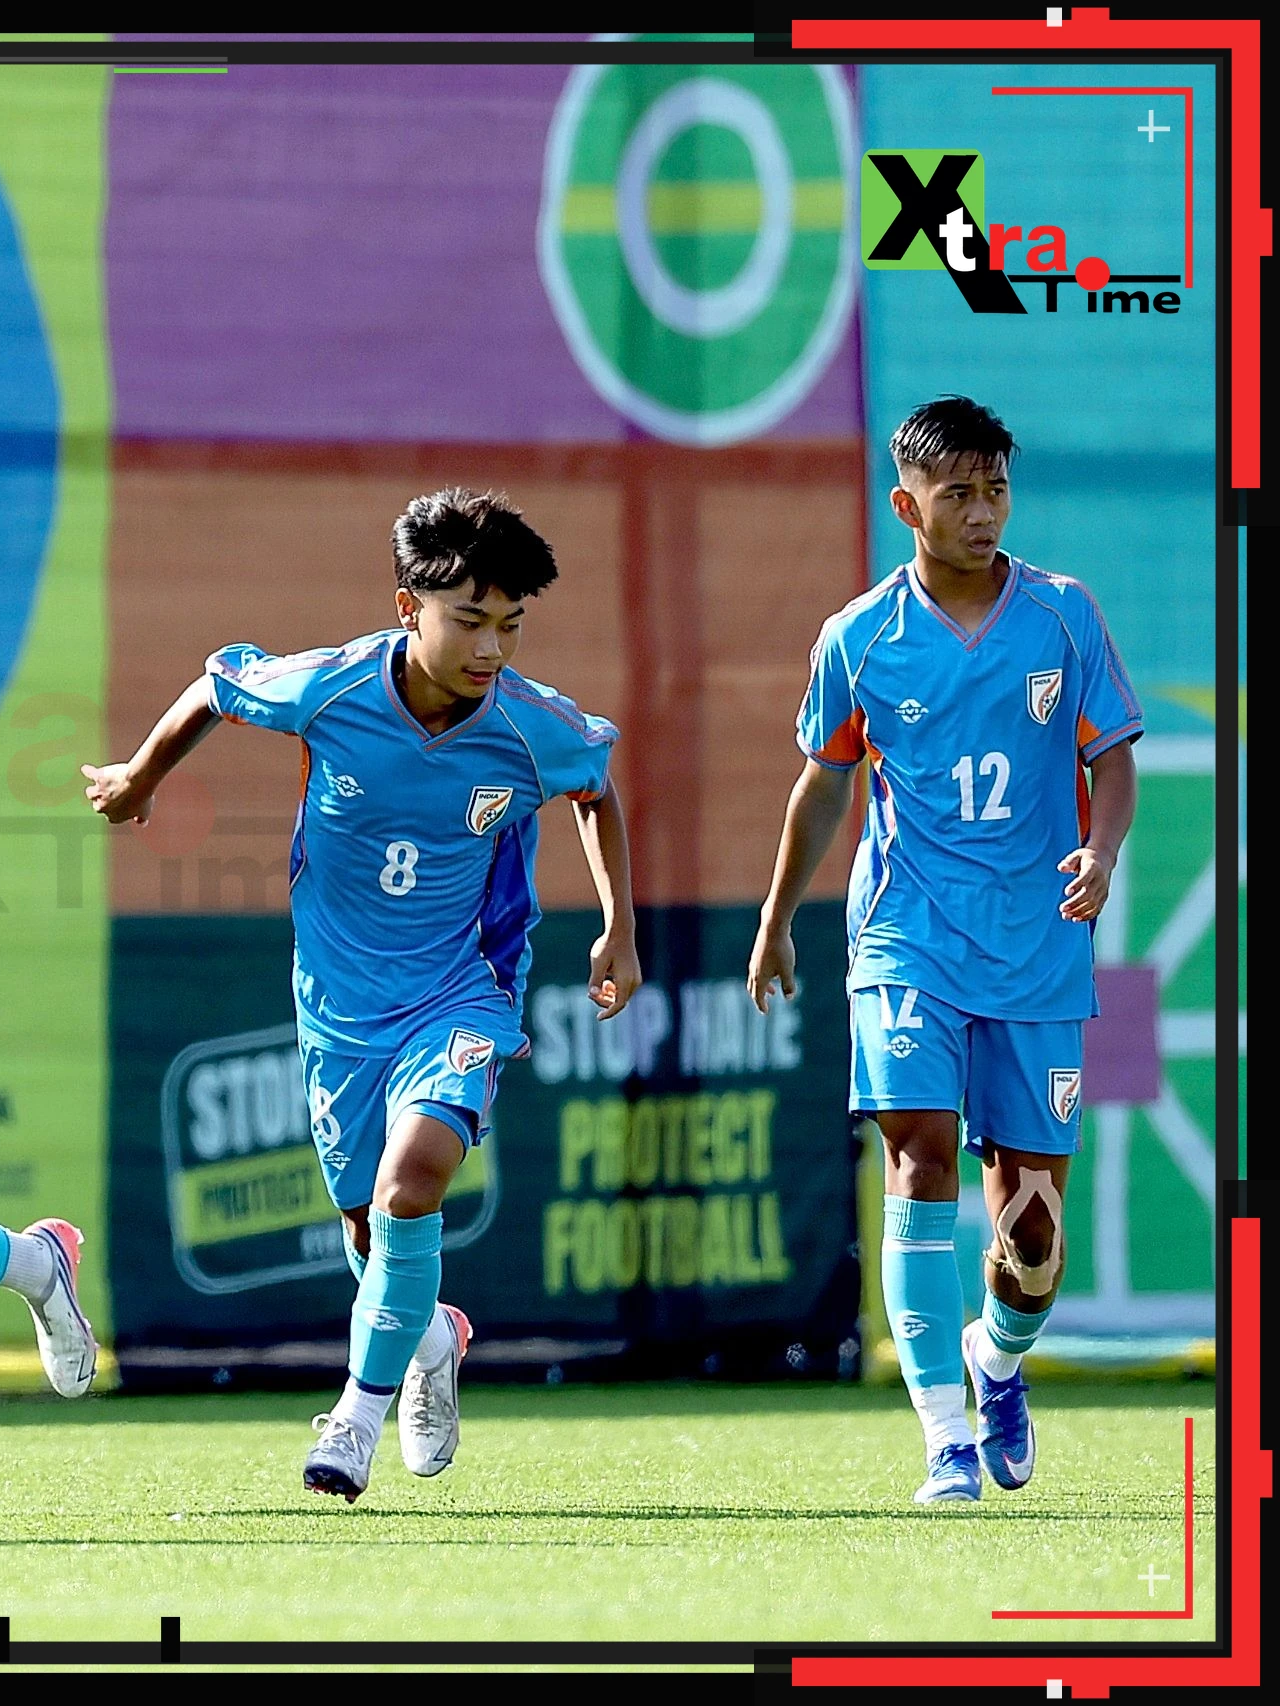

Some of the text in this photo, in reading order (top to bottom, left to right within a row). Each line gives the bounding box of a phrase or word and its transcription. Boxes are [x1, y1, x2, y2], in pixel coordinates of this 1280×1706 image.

[951, 751, 1012, 822] 12
[379, 840, 419, 897] 8
[559, 1089, 777, 1192] PROTECT
[543, 1190, 793, 1295] FOOTBALL
